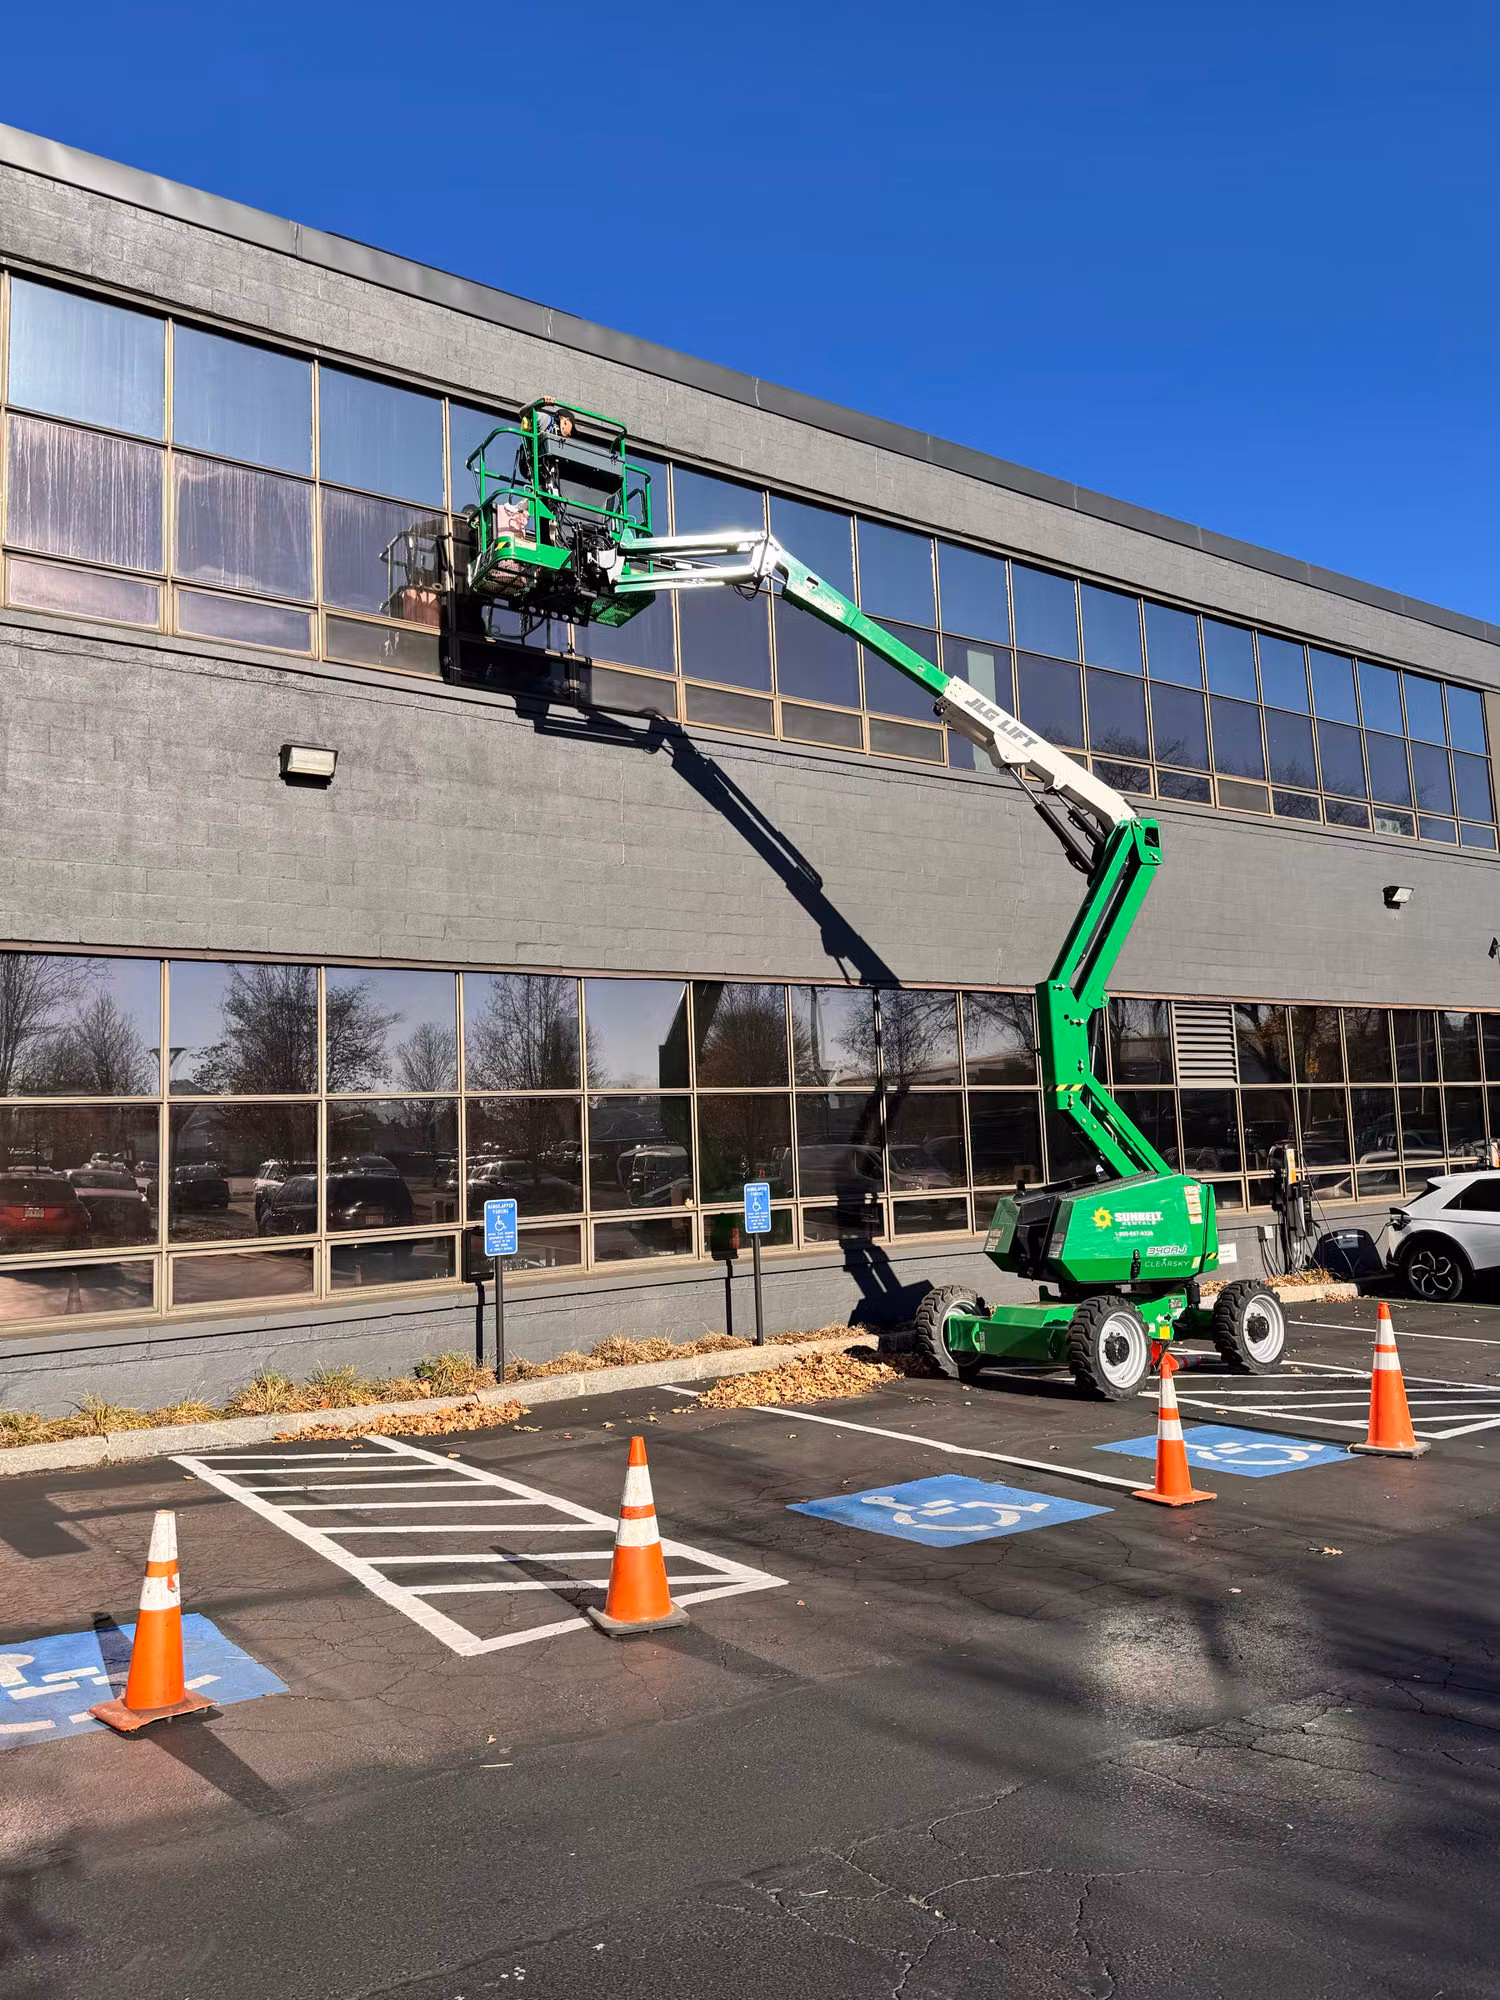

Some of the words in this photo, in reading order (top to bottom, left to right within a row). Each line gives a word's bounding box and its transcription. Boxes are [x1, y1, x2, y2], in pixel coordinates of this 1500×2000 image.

[964, 698, 1000, 721] JLG
[997, 719, 1038, 748] LIFT
[1114, 1211, 1162, 1222] SUNBELT
[1146, 1244, 1187, 1256] 340AJ
[1144, 1258, 1190, 1268] CLEARSKY
